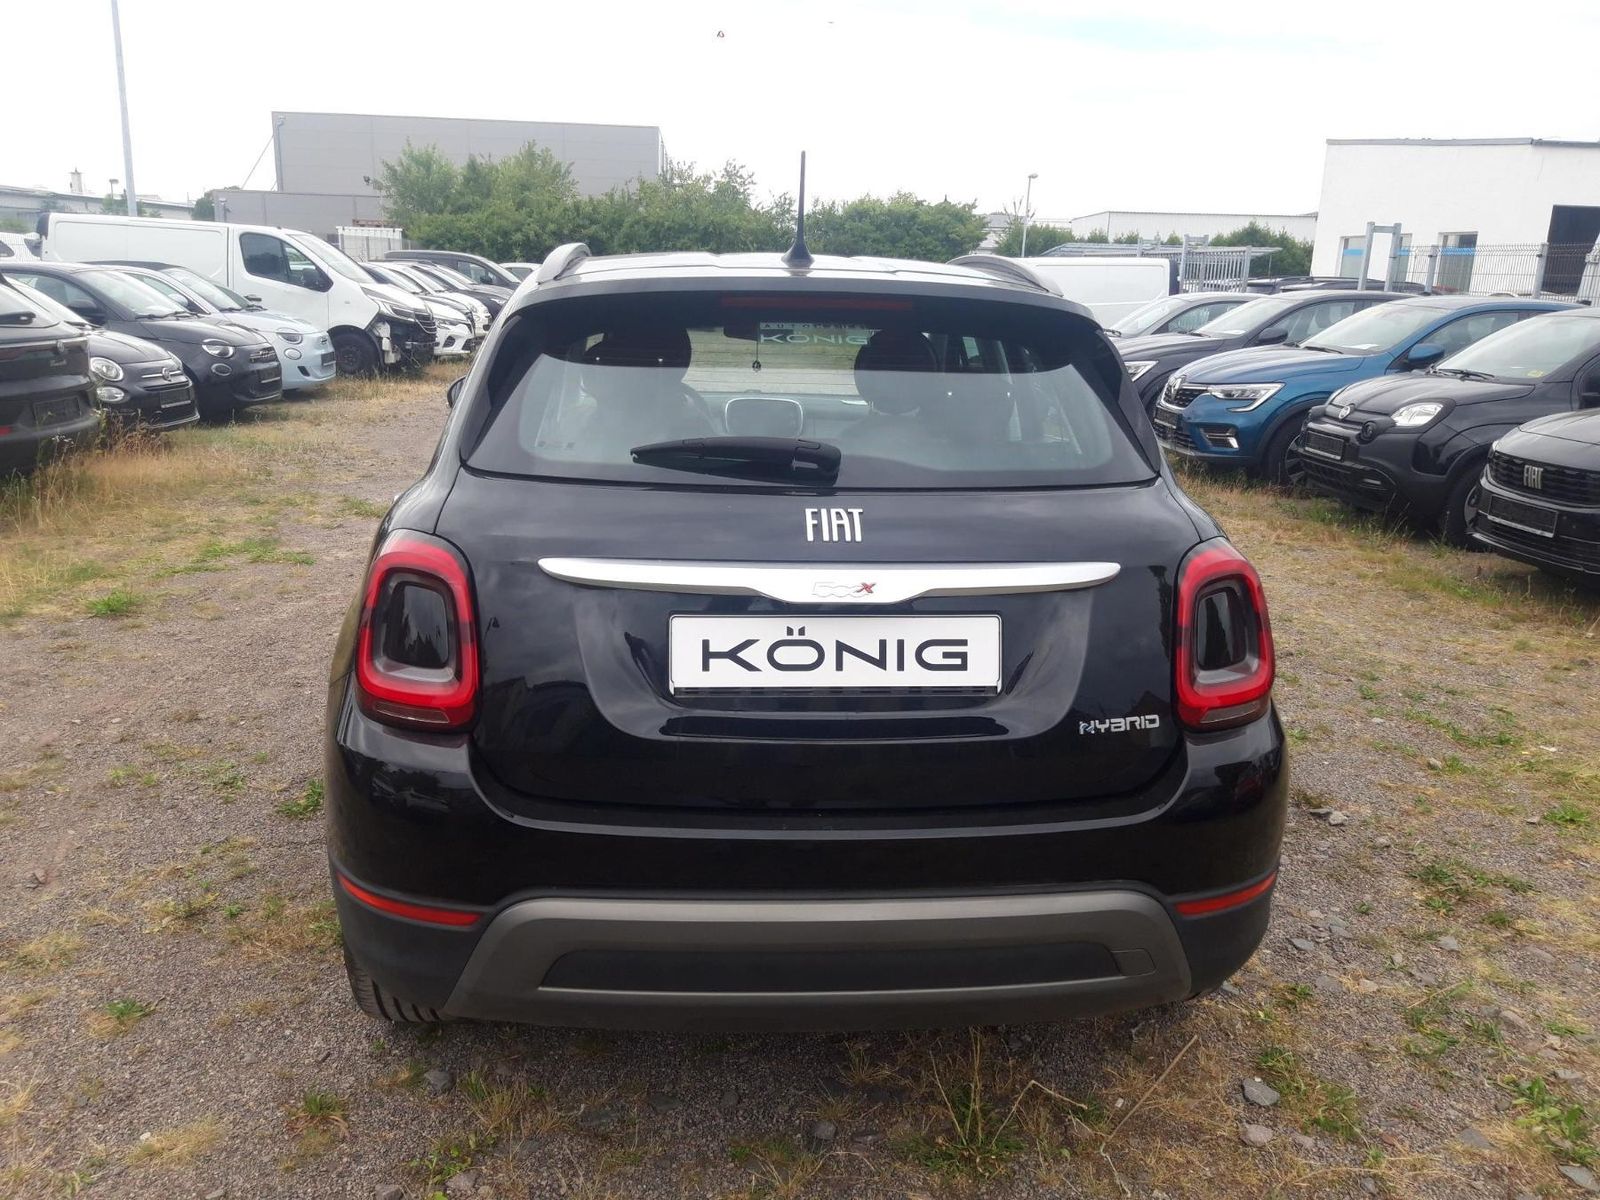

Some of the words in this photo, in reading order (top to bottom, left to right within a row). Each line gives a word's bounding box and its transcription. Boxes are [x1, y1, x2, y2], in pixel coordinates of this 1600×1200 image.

[1523, 464, 1543, 490] FIAT
[805, 508, 863, 542] FIAT
[701, 626, 968, 672] KÖNIG
[1079, 714, 1160, 735] HYBRID
